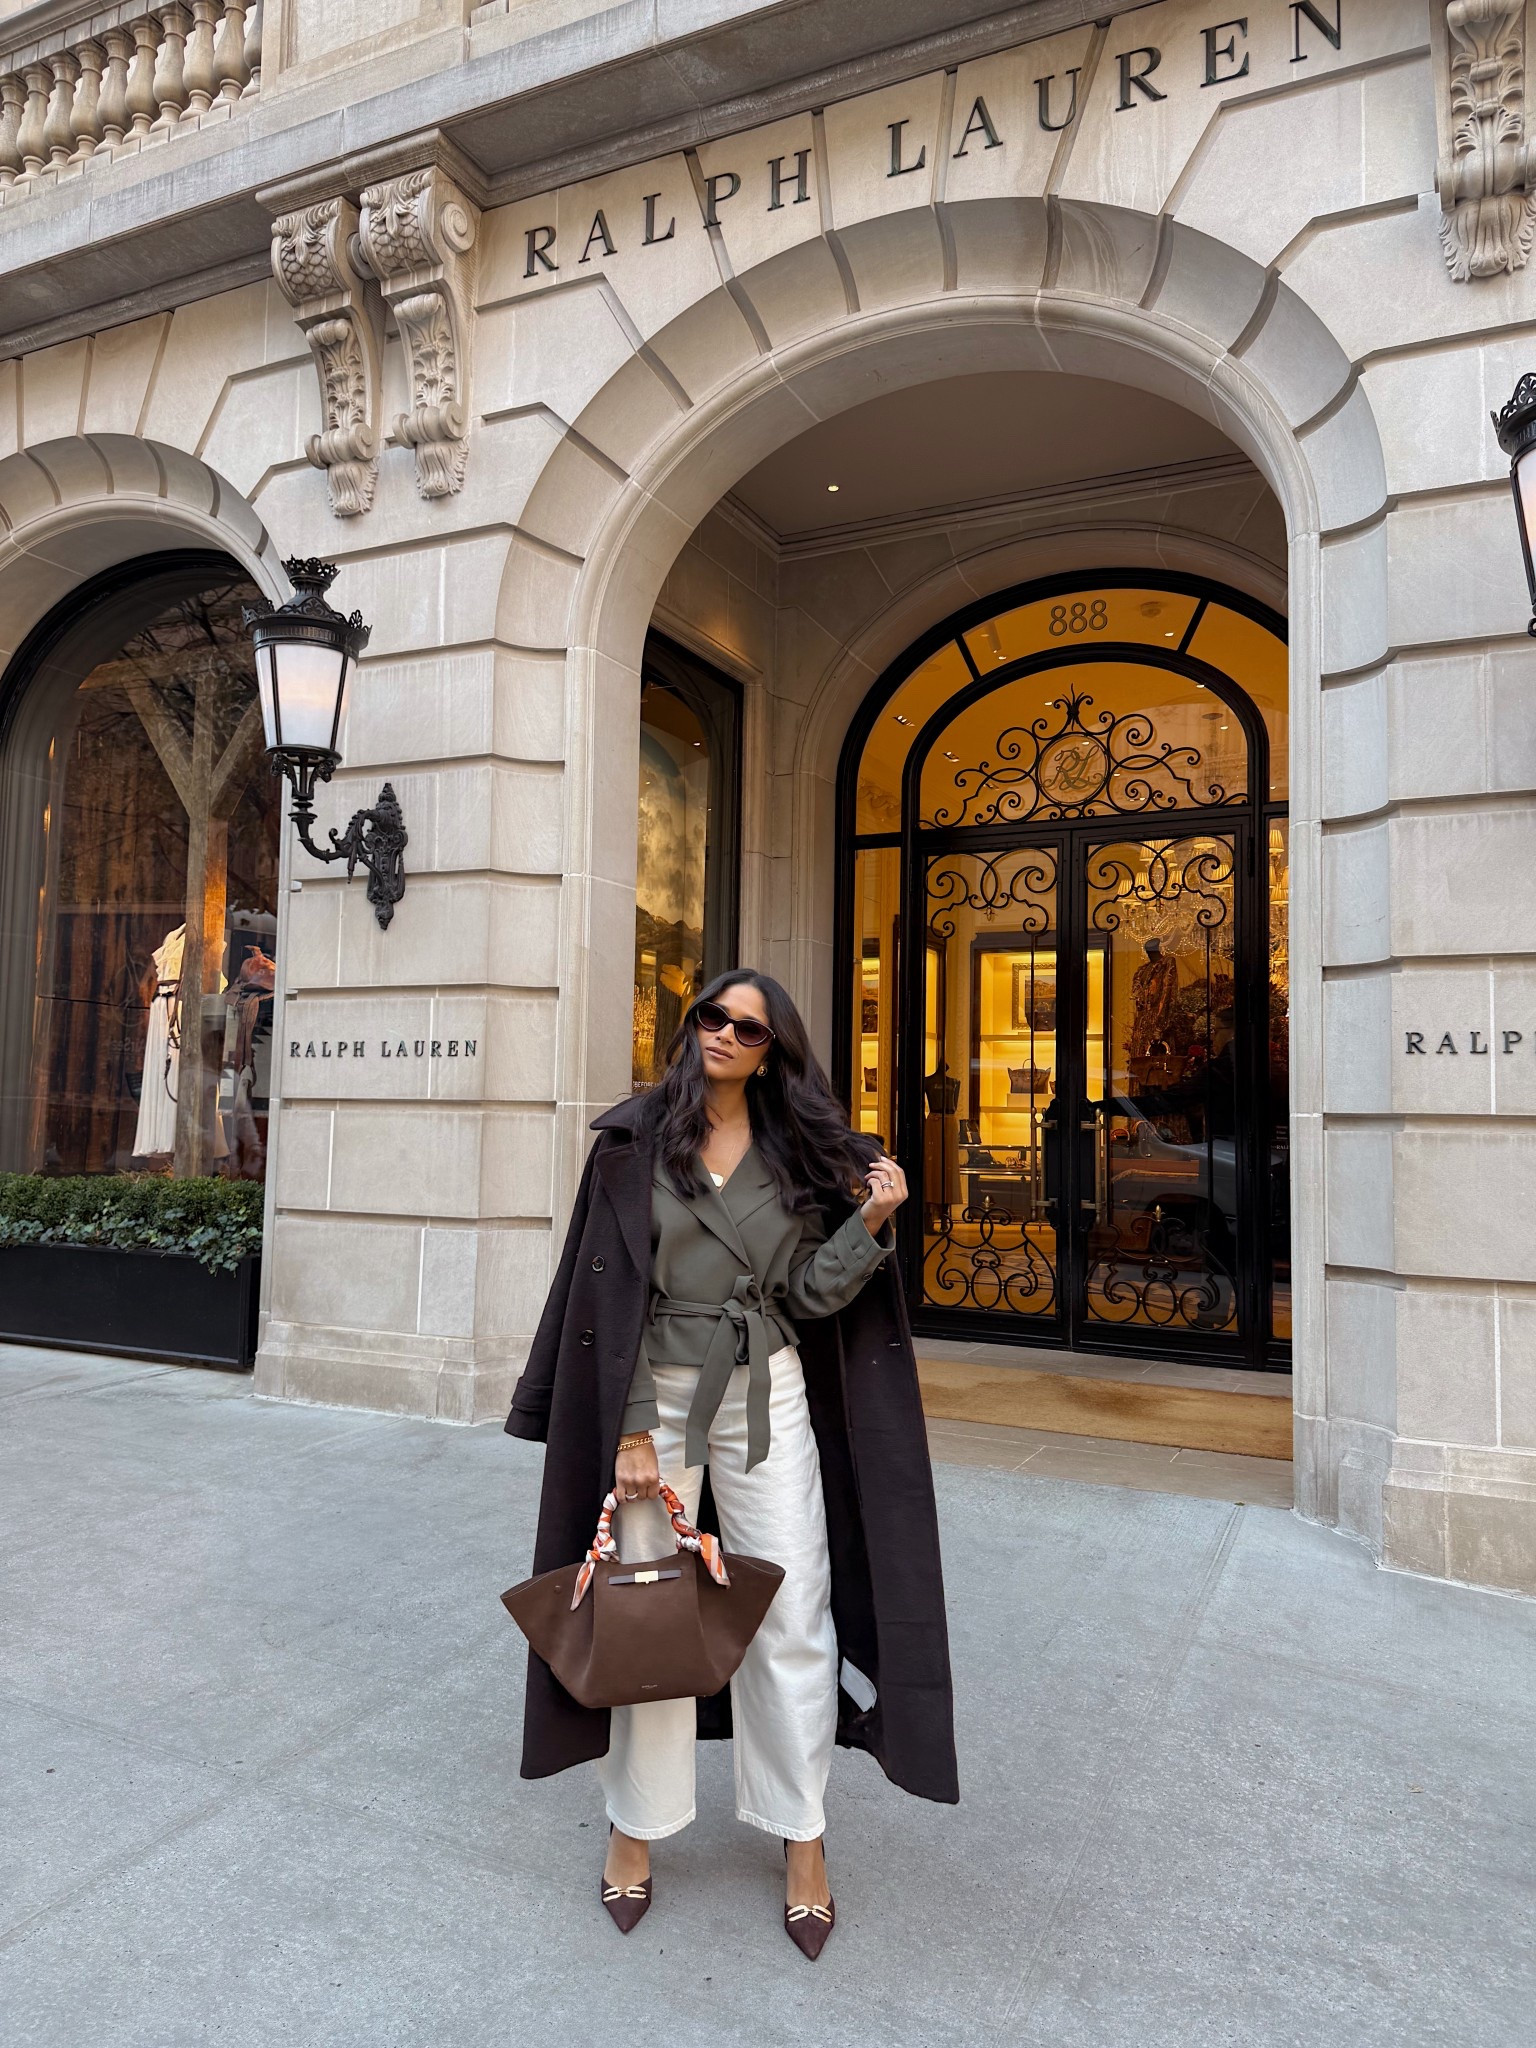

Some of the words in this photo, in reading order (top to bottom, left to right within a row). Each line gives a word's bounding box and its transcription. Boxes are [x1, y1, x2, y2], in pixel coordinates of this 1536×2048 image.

[523, 147, 812, 279] RALPH
[885, 0, 1341, 178] LAUREN
[1049, 599, 1108, 636] 888
[289, 1040, 365, 1058] RALPH
[380, 1040, 478, 1058] LAUREN
[1405, 1031, 1536, 1054] RALP
